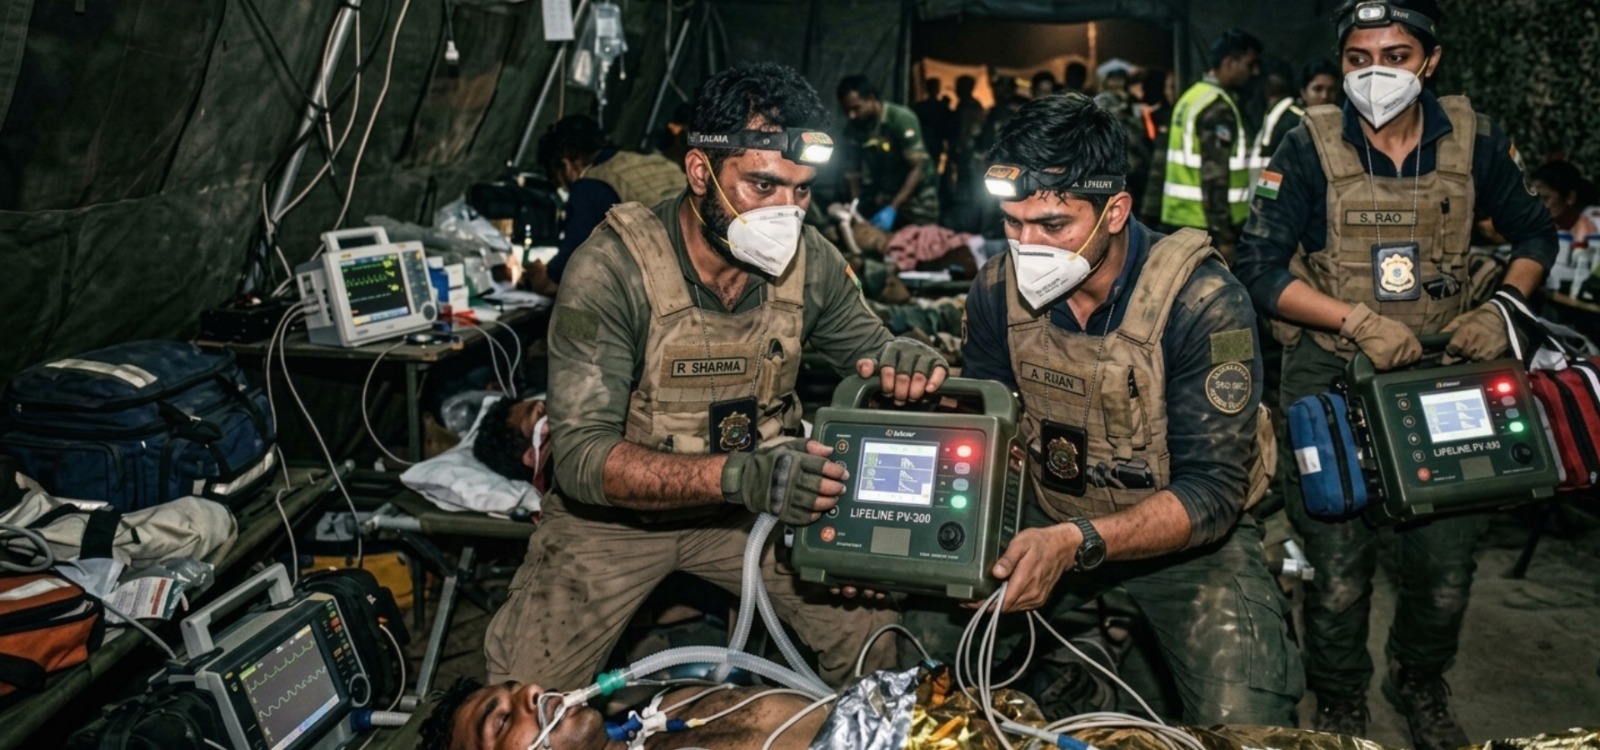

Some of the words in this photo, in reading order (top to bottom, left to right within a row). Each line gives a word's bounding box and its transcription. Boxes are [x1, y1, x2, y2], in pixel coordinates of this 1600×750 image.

[1375, 212, 1402, 223] RAO
[677, 362, 686, 374] R
[692, 361, 741, 373] SHARMA
[1031, 368, 1039, 379] A
[1433, 443, 1473, 458] LIFELINE
[850, 507, 894, 521] LIFELINE
[896, 511, 931, 524] PV-300
